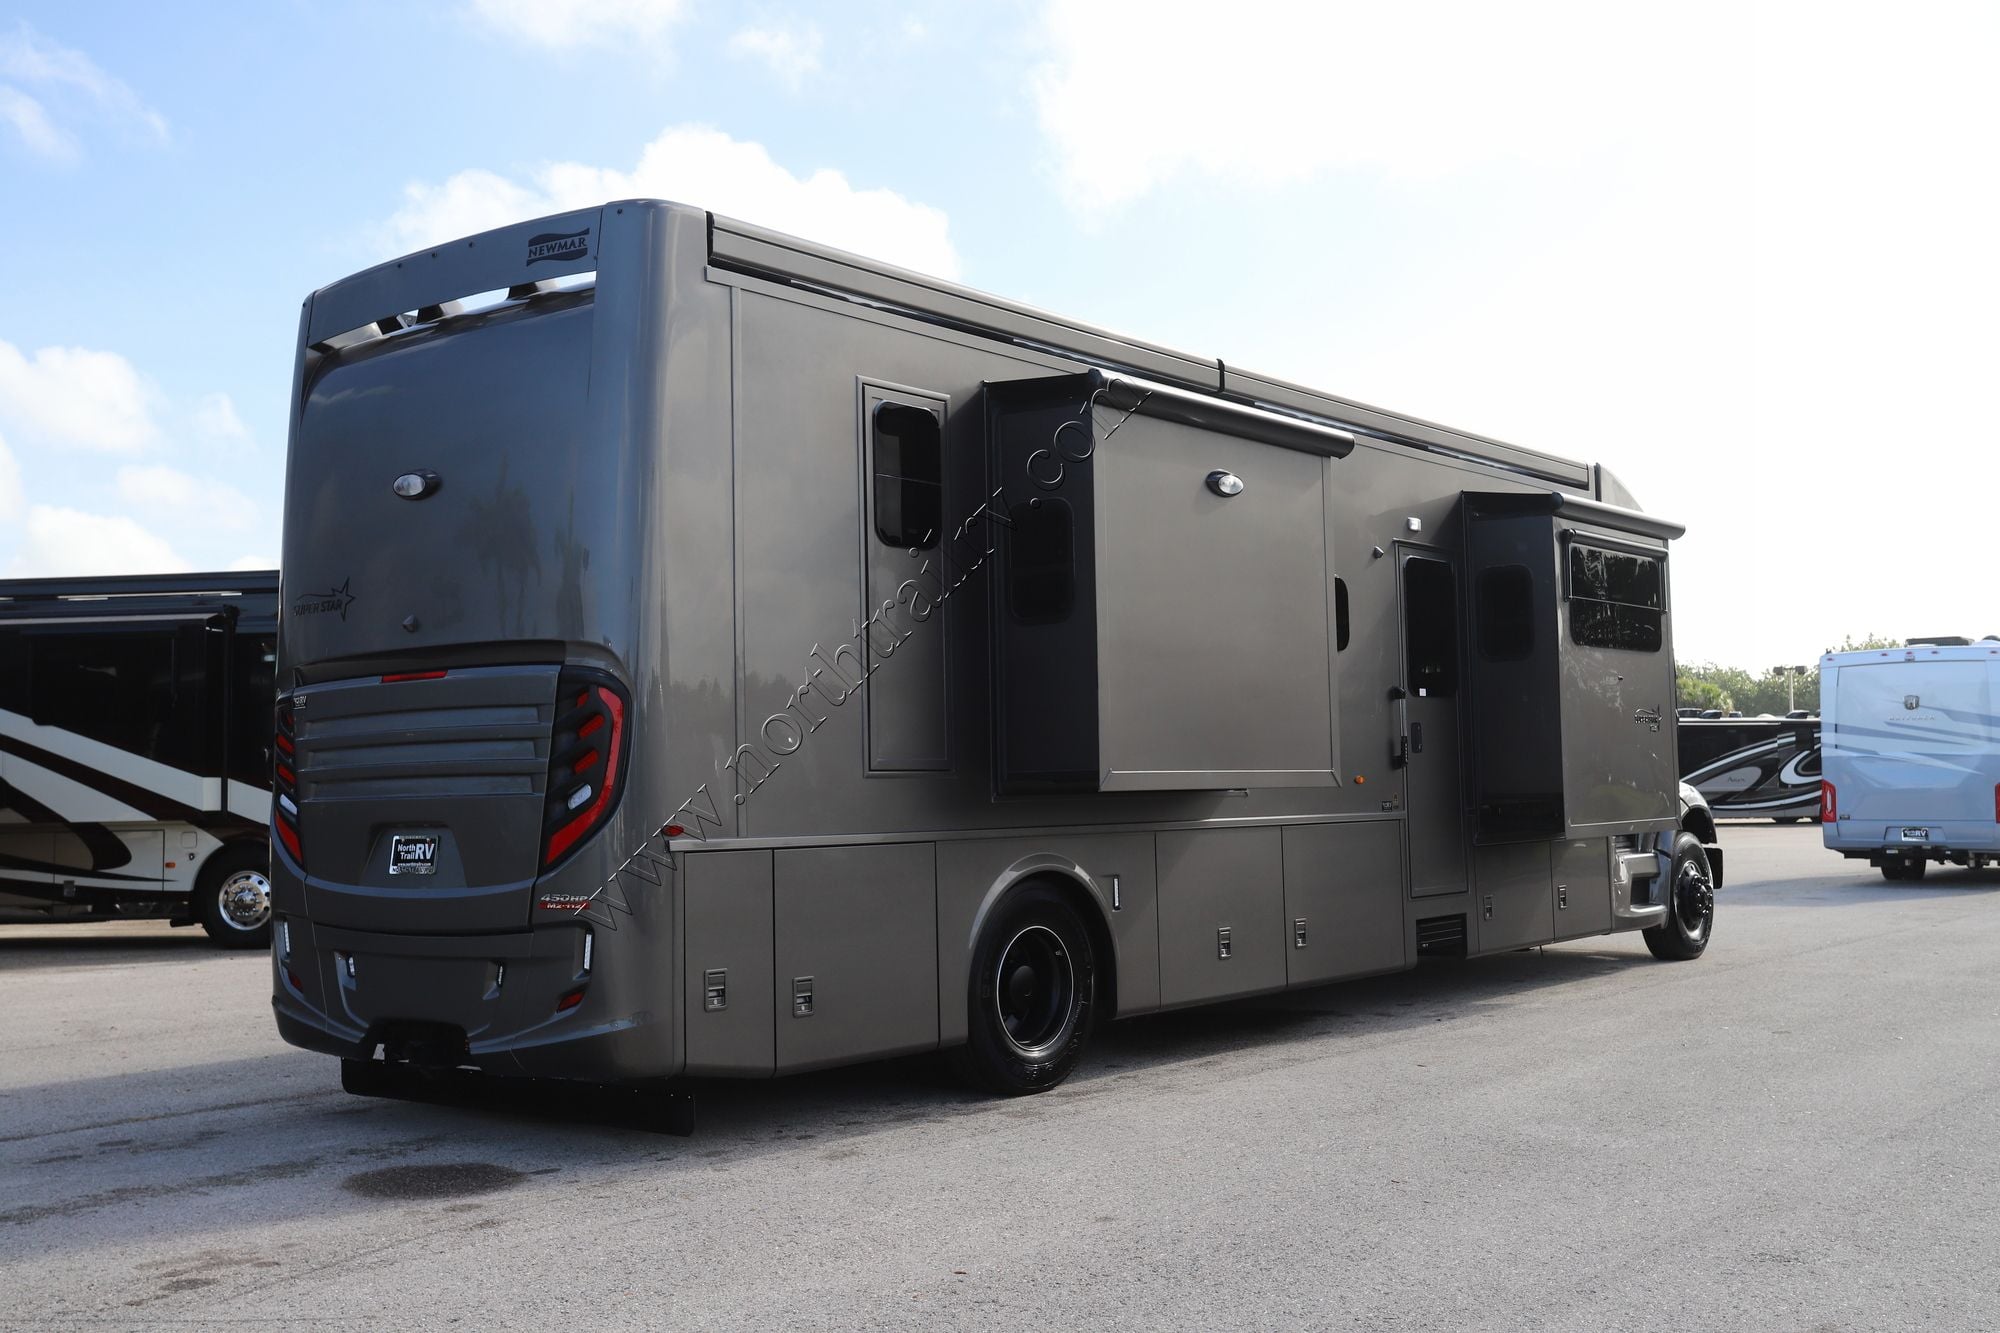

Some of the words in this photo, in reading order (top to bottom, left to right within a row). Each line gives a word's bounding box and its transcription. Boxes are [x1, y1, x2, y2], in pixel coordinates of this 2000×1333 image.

[528, 237, 588, 258] NEWMAR
[293, 602, 319, 616] SUPER
[320, 599, 342, 612] STAR
[397, 843, 415, 852] North
[415, 843, 435, 860] RV
[400, 852, 415, 860] Trail
[540, 893, 588, 902] 450HP
